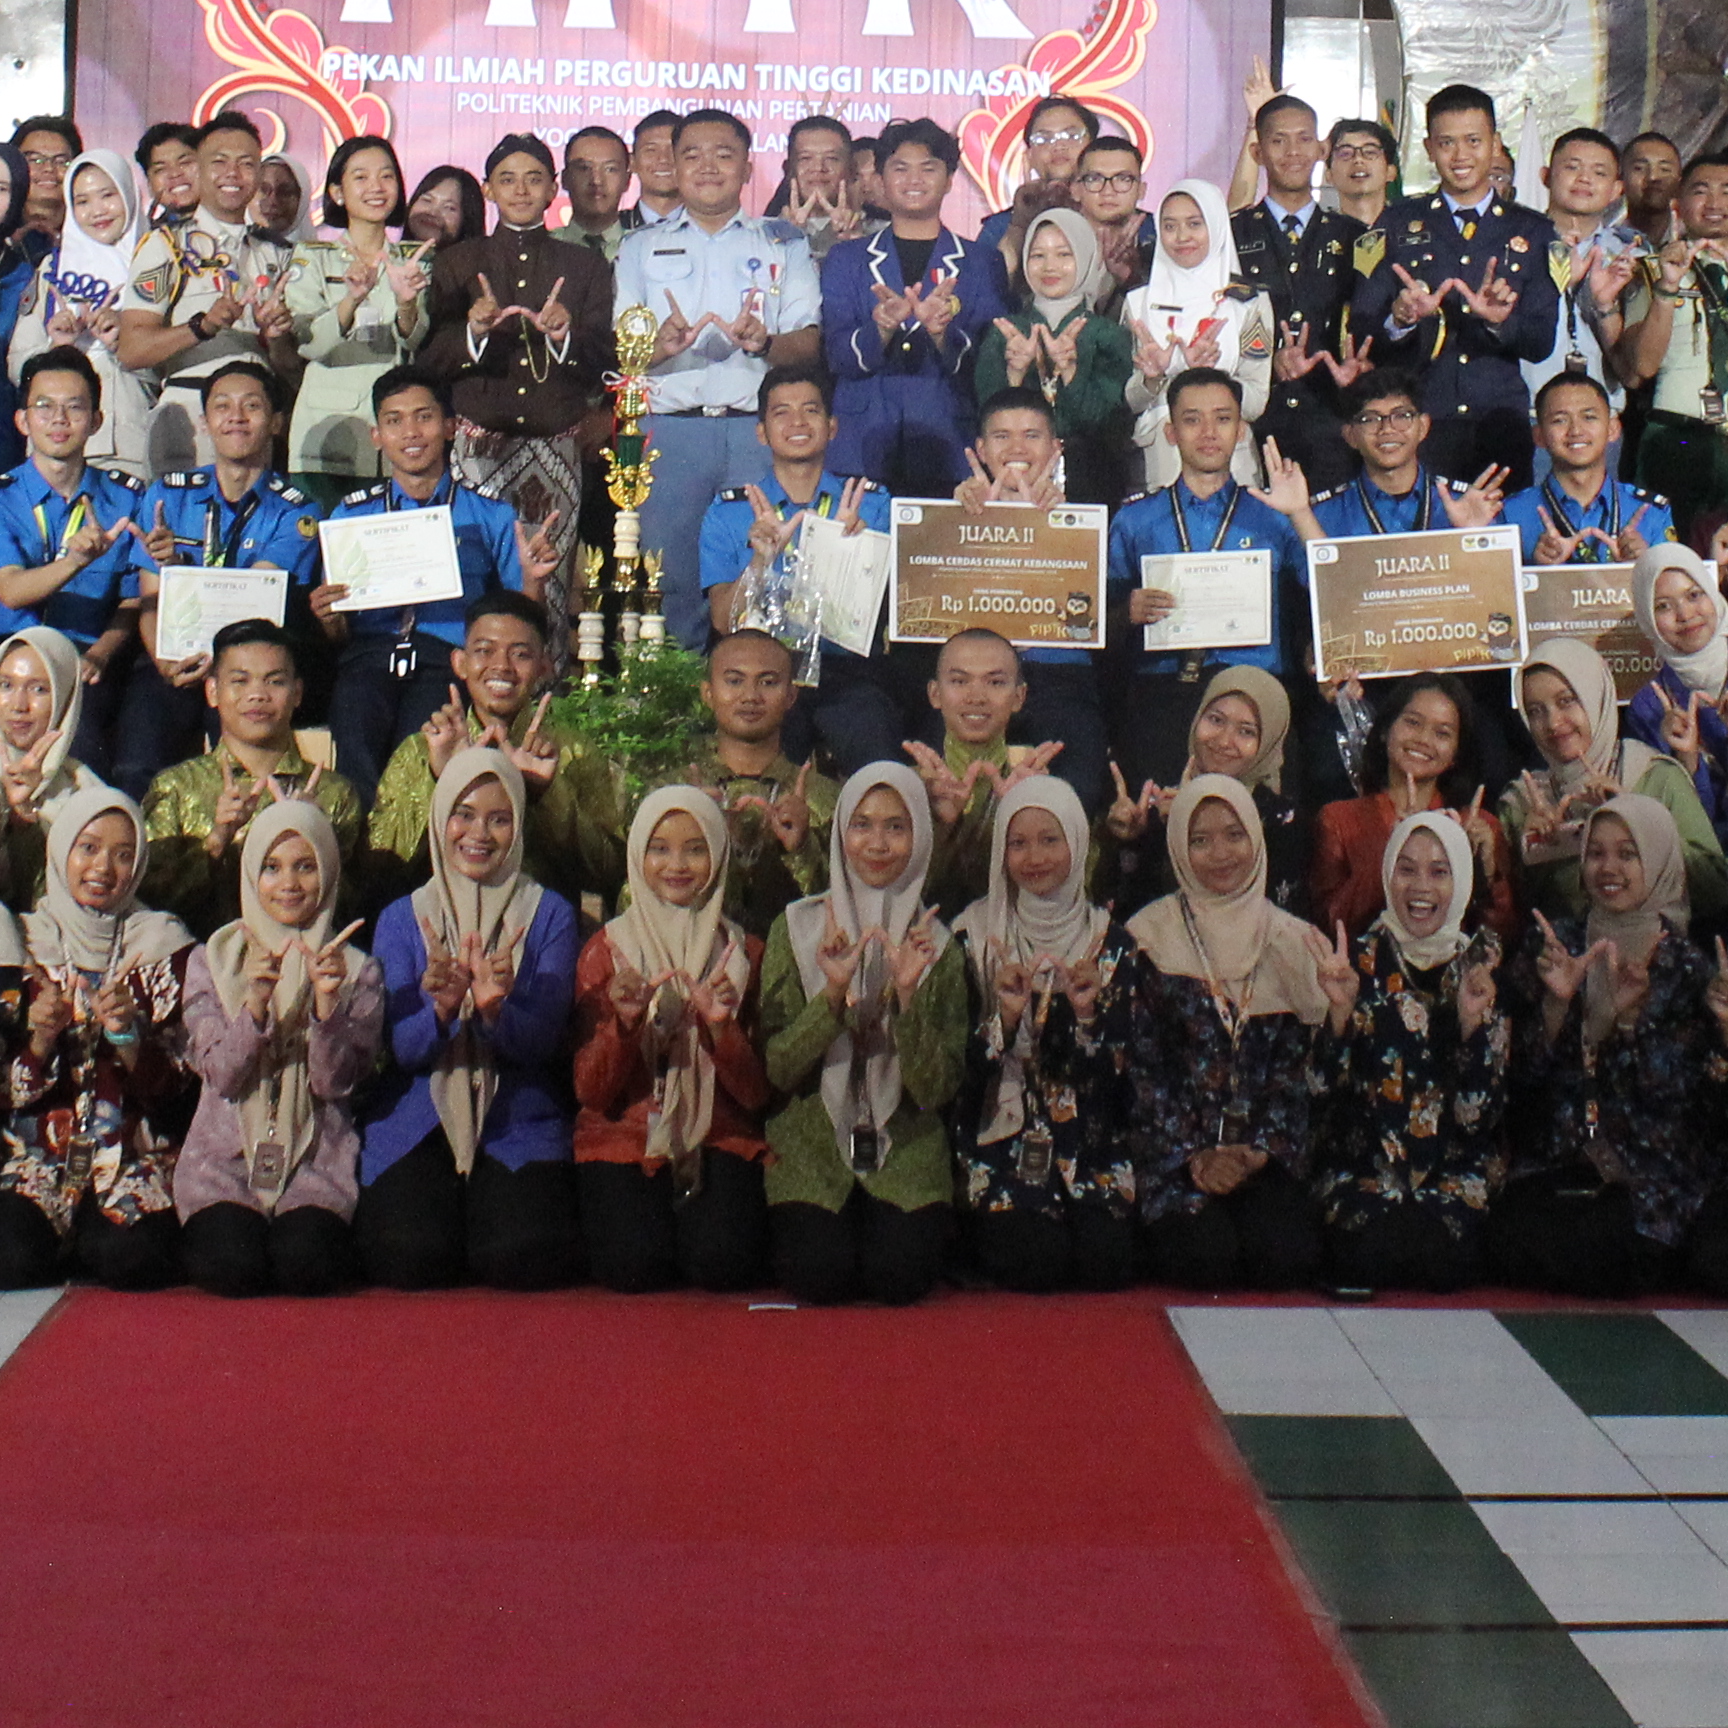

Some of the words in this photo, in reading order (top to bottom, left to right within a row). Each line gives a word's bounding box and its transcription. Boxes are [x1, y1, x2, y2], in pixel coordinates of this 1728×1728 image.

[322, 53, 423, 83] PEKAN
[435, 56, 544, 84] ILMIAH
[555, 58, 746, 90] PERGURUAN
[754, 64, 862, 93] TINGGI
[872, 66, 1052, 97] KEDINASAN
[457, 92, 583, 115] POLITEKNIK
[958, 525, 1019, 544] JUARA
[1023, 527, 1034, 543] II
[909, 555, 944, 566] LOMBA
[946, 557, 982, 567] CERDAS
[984, 558, 1021, 568] CERMAT
[1023, 559, 1088, 570] KEBANGSAAN
[1375, 555, 1435, 577] JUARA
[1439, 554, 1450, 570] II
[1363, 590, 1398, 601] LOMBA
[1399, 587, 1443, 598] BUSINESS
[1445, 584, 1470, 595] PLAN
[1572, 588, 1631, 608] JUARA
[941, 595, 963, 614] Rp
[968, 595, 1055, 614] 1.000.000
[1364, 630, 1386, 648] Rp
[1391, 622, 1478, 644] 1.000.000
[1528, 622, 1562, 632] LOMBA
[1563, 621, 1599, 630] CERDAS
[1608, 656, 1664, 673] 50.000
